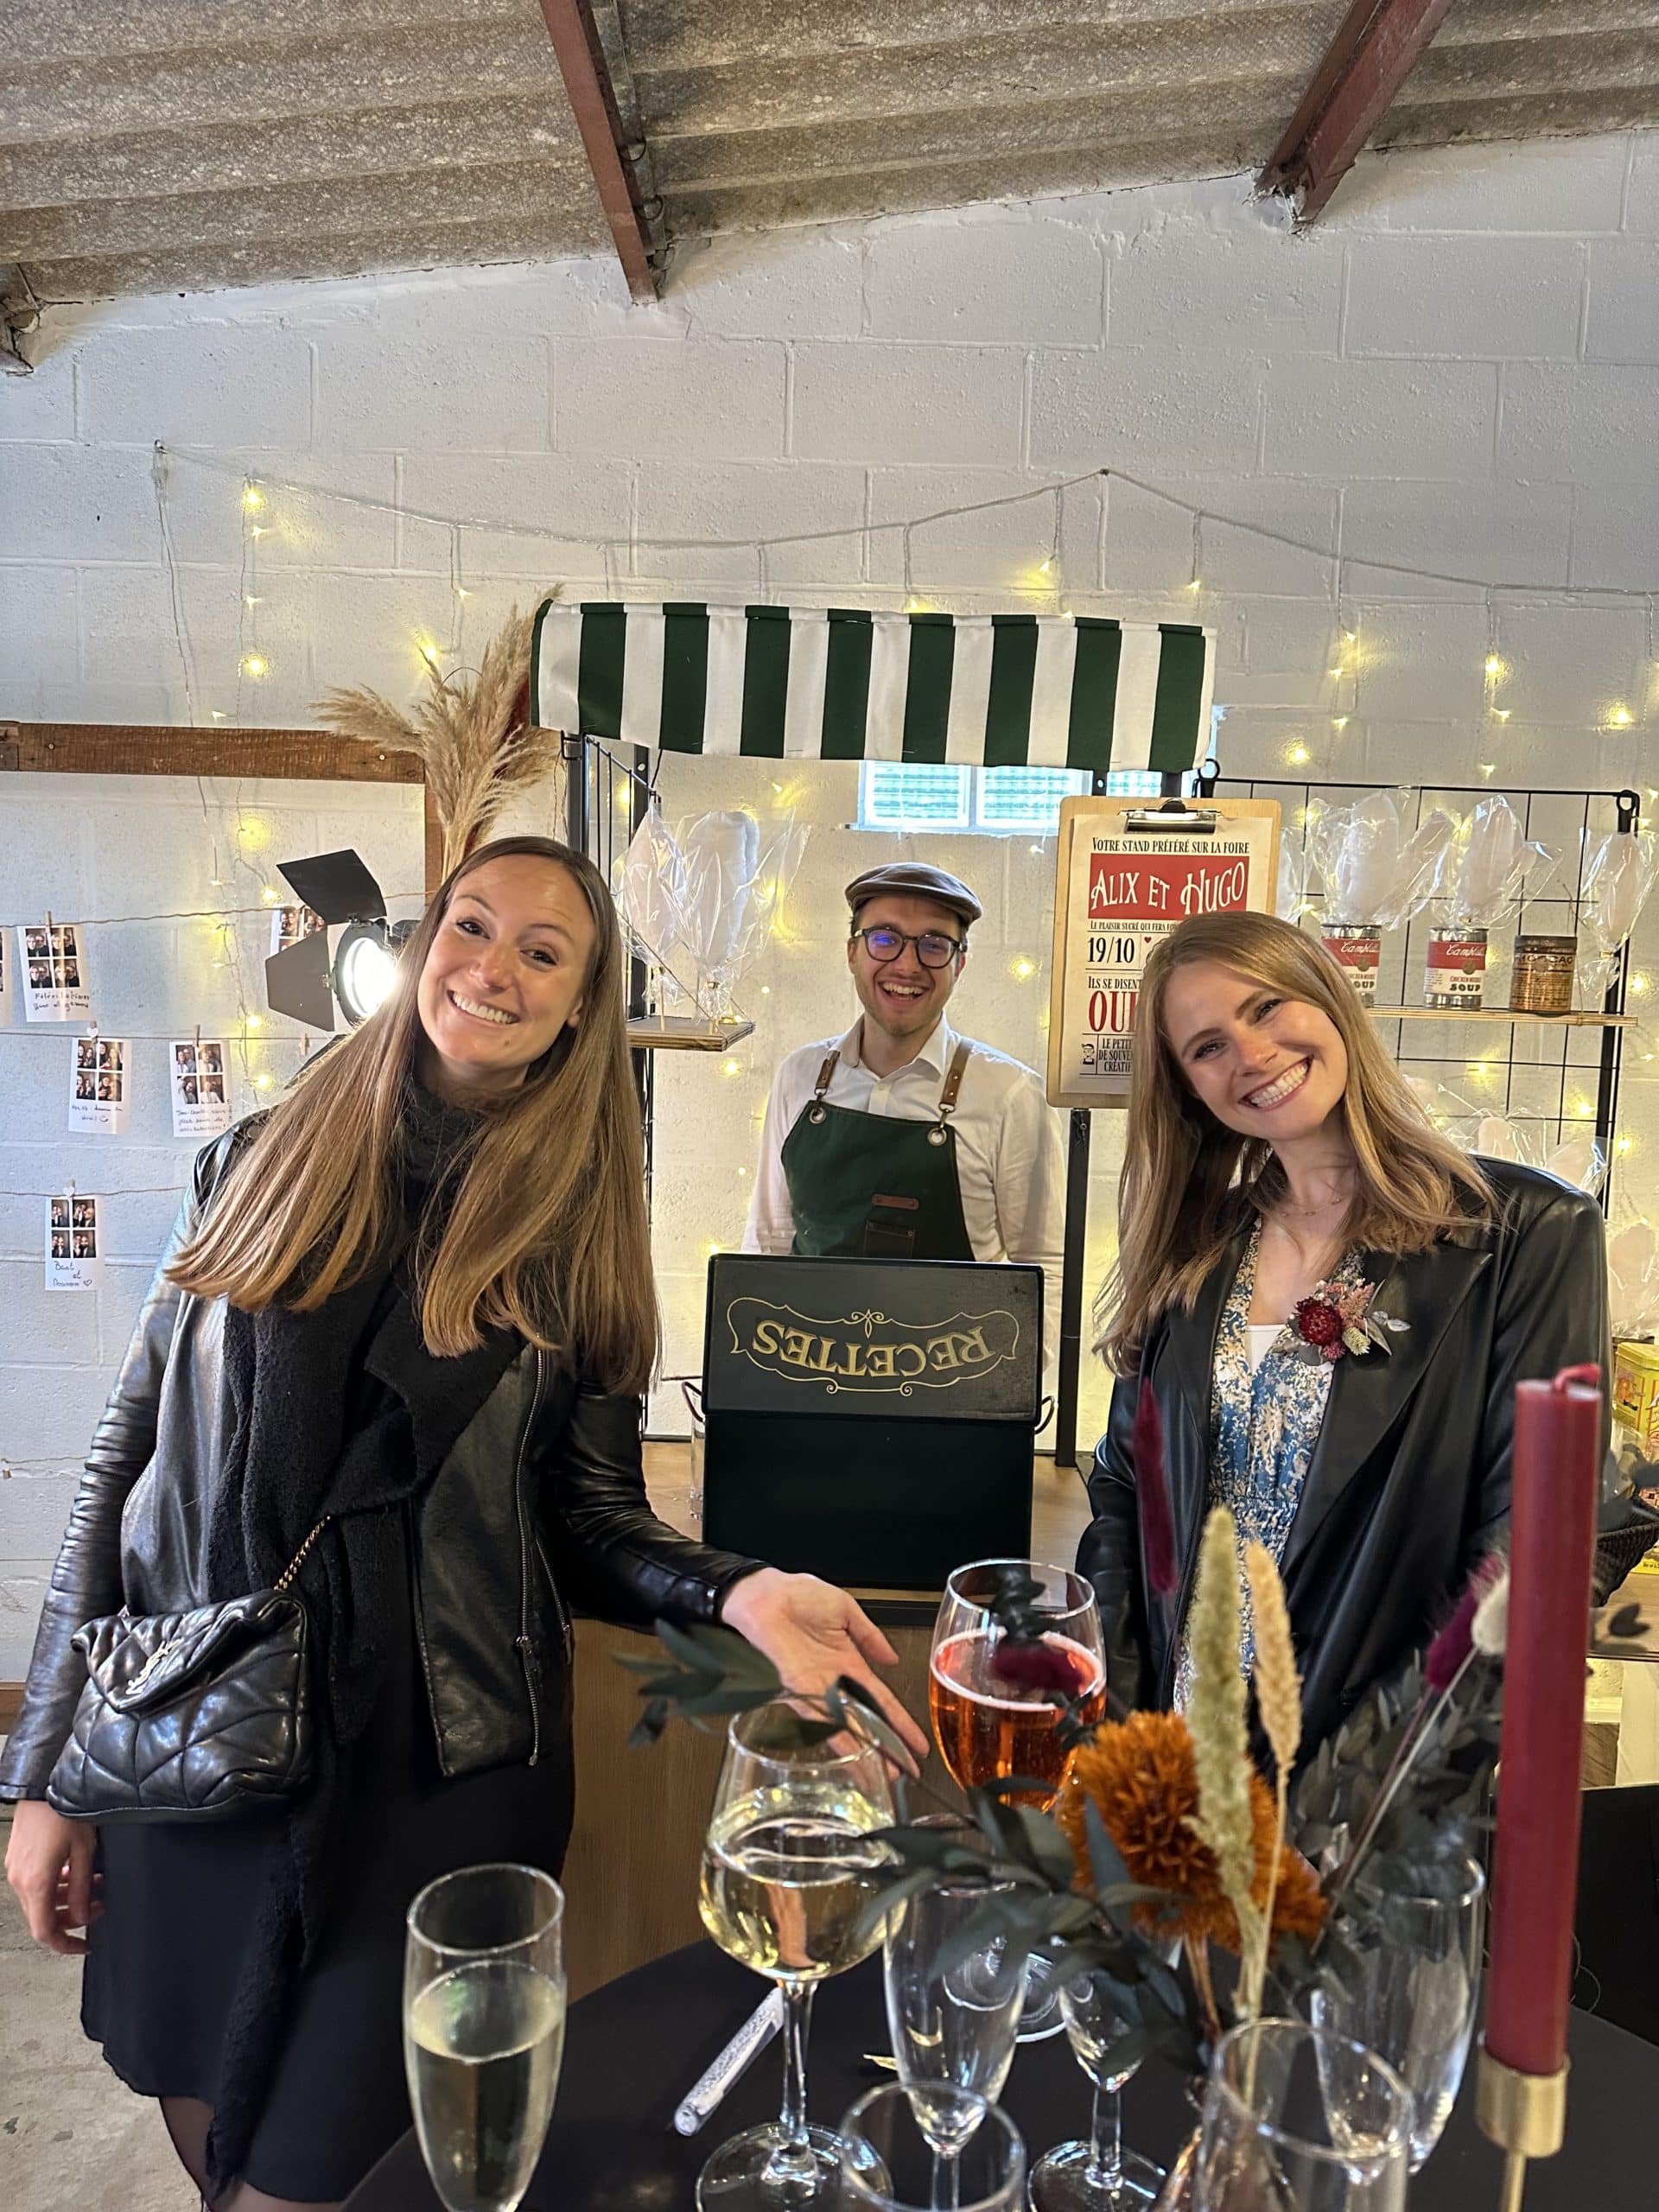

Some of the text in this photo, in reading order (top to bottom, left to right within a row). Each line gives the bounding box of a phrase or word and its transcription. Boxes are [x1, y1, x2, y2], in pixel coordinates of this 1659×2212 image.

[1092, 837, 1249, 855] VOTRE STAND PRÉFÉRÉ SUR LA FOIRE
[1090, 861, 1245, 915] ALIX ET HUGO
[1098, 921, 1121, 931] PLAISIR
[1122, 921, 1139, 931] SUCRÉ
[1141, 922, 1150, 931] QUI
[1087, 937, 1135, 963] 19/10
[1103, 978, 1112, 988] SE
[1353, 980, 1375, 989] OUP
[1449, 983, 1481, 992] SOUP
[1103, 1038, 1110, 1049] LE
[1099, 1050, 1134, 1061] DE SOUVE
[752, 1319, 997, 1378] RECETTES
